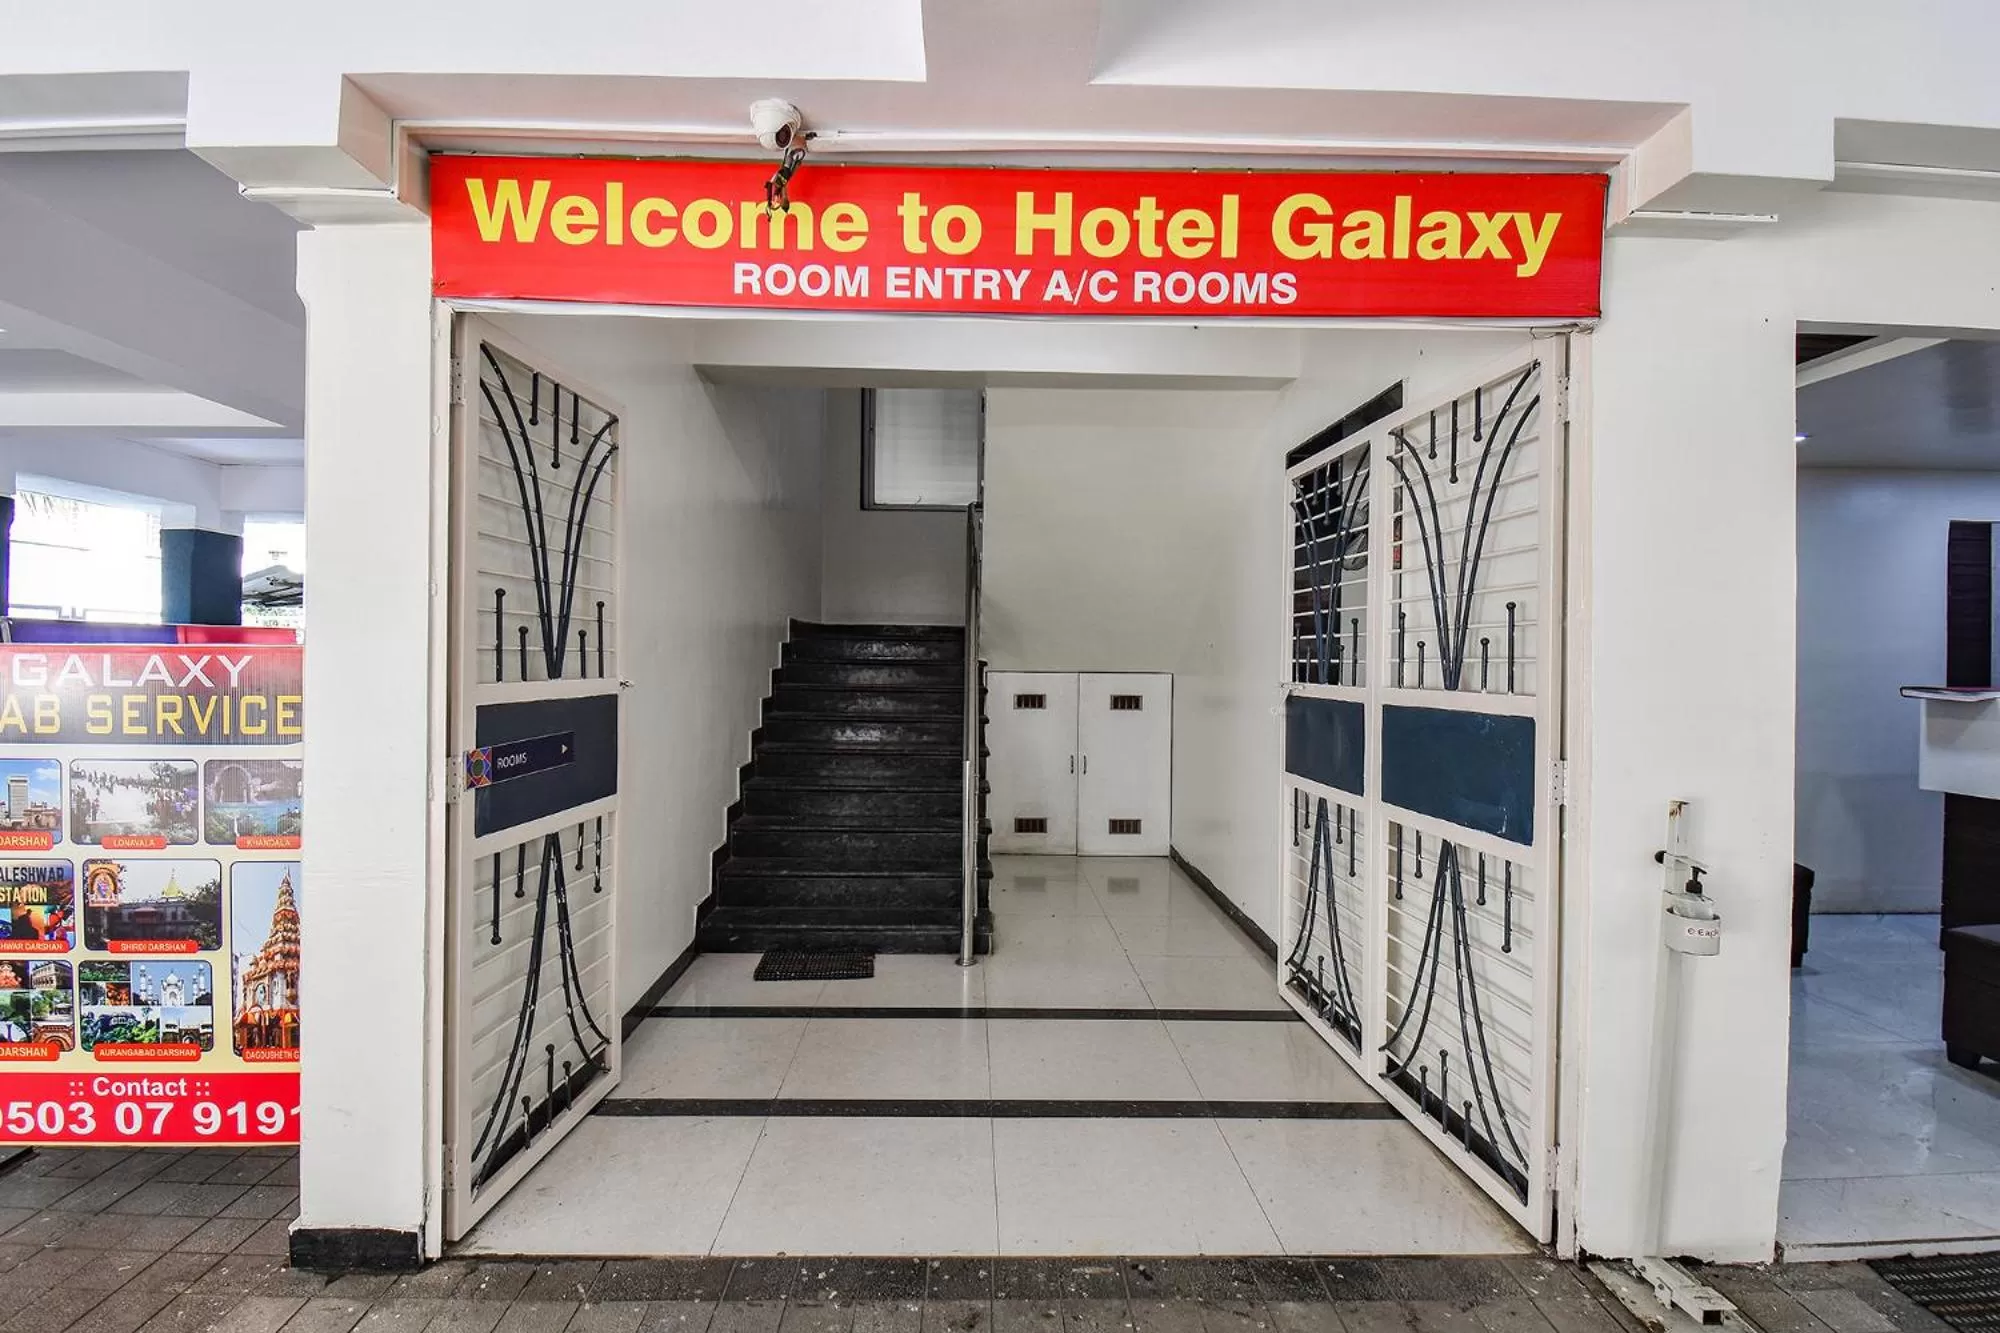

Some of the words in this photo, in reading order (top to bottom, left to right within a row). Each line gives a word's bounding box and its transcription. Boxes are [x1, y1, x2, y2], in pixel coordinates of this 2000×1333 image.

[465, 178, 868, 253] Welcome
[897, 192, 981, 255] to
[1015, 190, 1239, 259] Hotel
[1271, 193, 1562, 278] Galaxy
[733, 262, 869, 297] ROOM
[886, 266, 1029, 300] ENTRY
[1042, 269, 1118, 305] A/C
[1133, 271, 1298, 305] ROOMS
[12, 653, 253, 687] GALAXY
[86, 695, 302, 735] SERVICE
[497, 752, 527, 769] ROOMS
[0, 886, 48, 902] STATION
[148, 943, 186, 951] DARSHAN
[100, 1048, 155, 1057] AURANGABAD
[156, 1048, 197, 1057] DARSHAN
[92, 1077, 187, 1097] Contact
[0, 1101, 96, 1136] 503
[114, 1101, 174, 1136] 07
